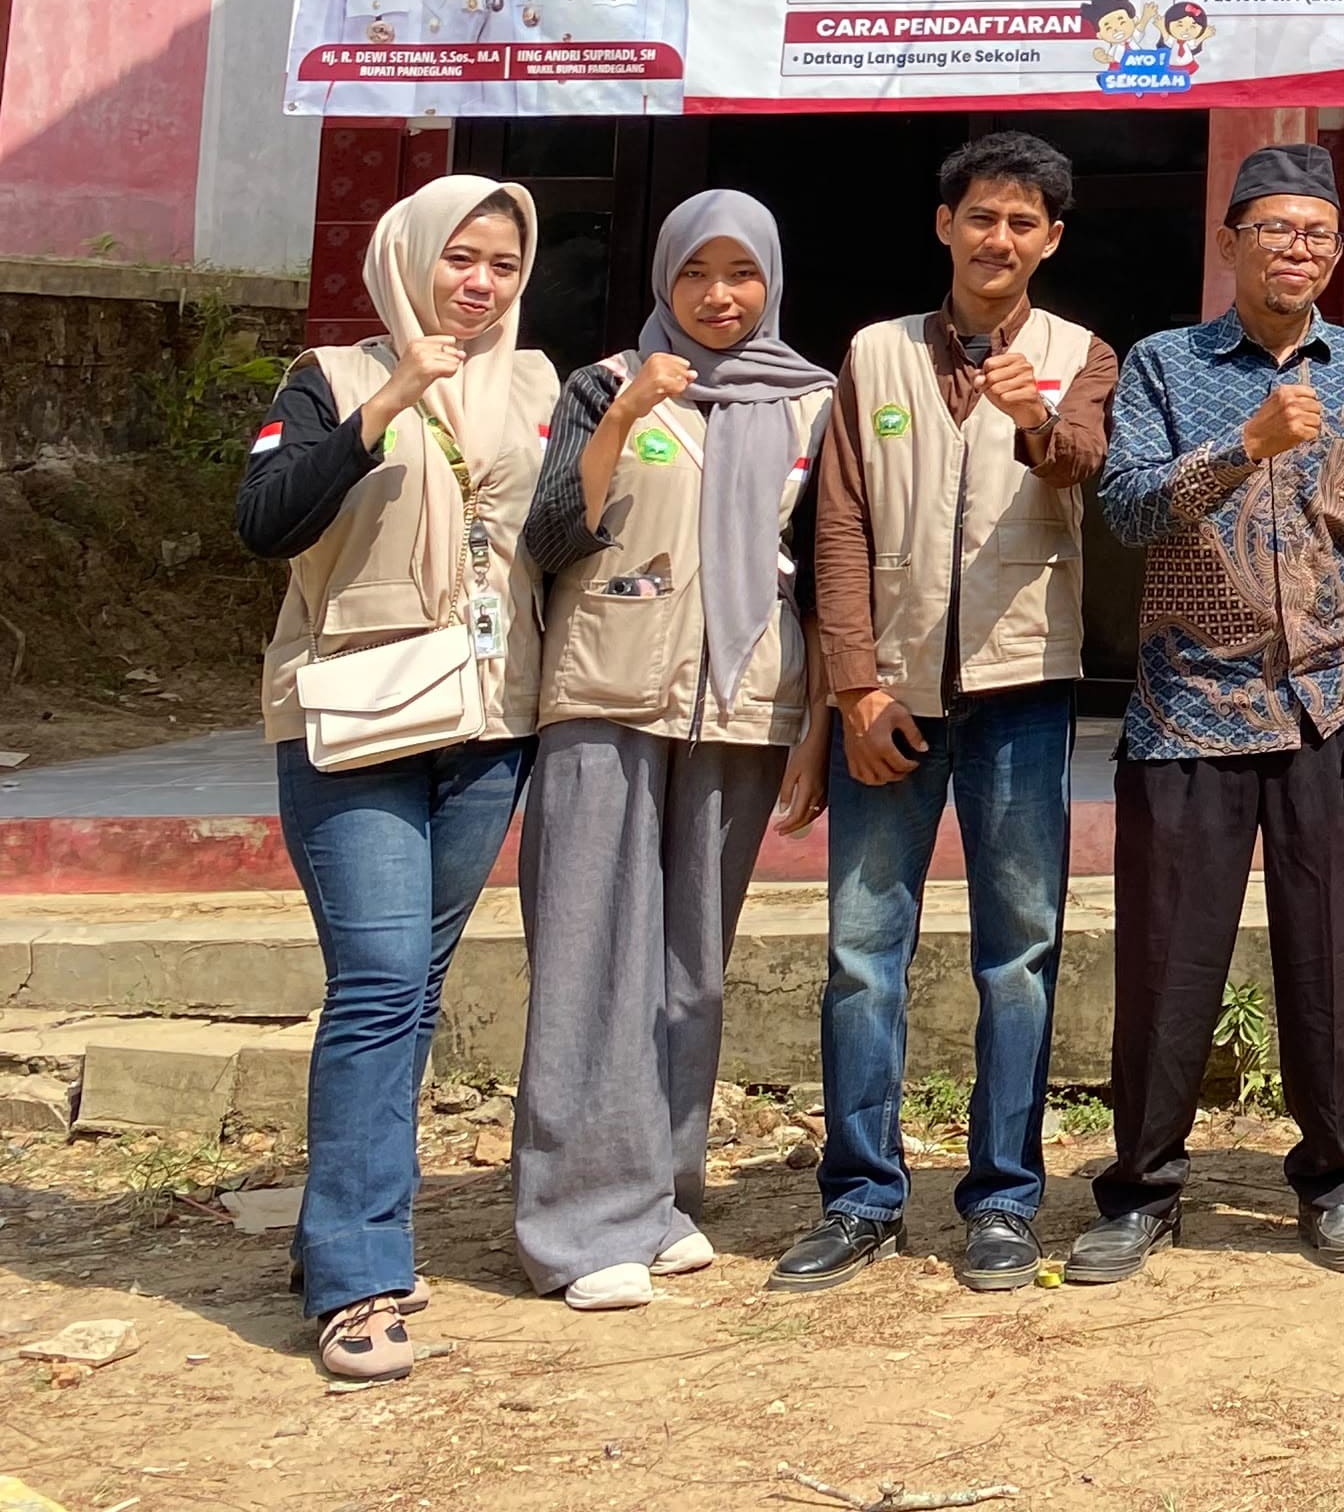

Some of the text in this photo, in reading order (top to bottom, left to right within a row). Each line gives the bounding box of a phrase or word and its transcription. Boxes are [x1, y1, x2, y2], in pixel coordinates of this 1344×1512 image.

[816, 15, 1081, 37] CARA PENDAFTARAN
[322, 51, 337, 66] Hj.
[341, 51, 353, 63] R.
[355, 51, 387, 63] DEWI
[390, 51, 437, 65] SETIANI,
[477, 50, 500, 62] M.A
[517, 49, 656, 62] IING ANDRI SUPRIADI, SH
[803, 49, 1040, 68] Datang Langsung Ke Sekolah
[1125, 55, 1156, 66] AYO
[359, 65, 463, 77] BUPATI PANDEGLANG
[555, 64, 586, 74] BUPATI
[587, 63, 645, 74] PANDEGLANG
[1105, 74, 1185, 88] SEKOLAH
